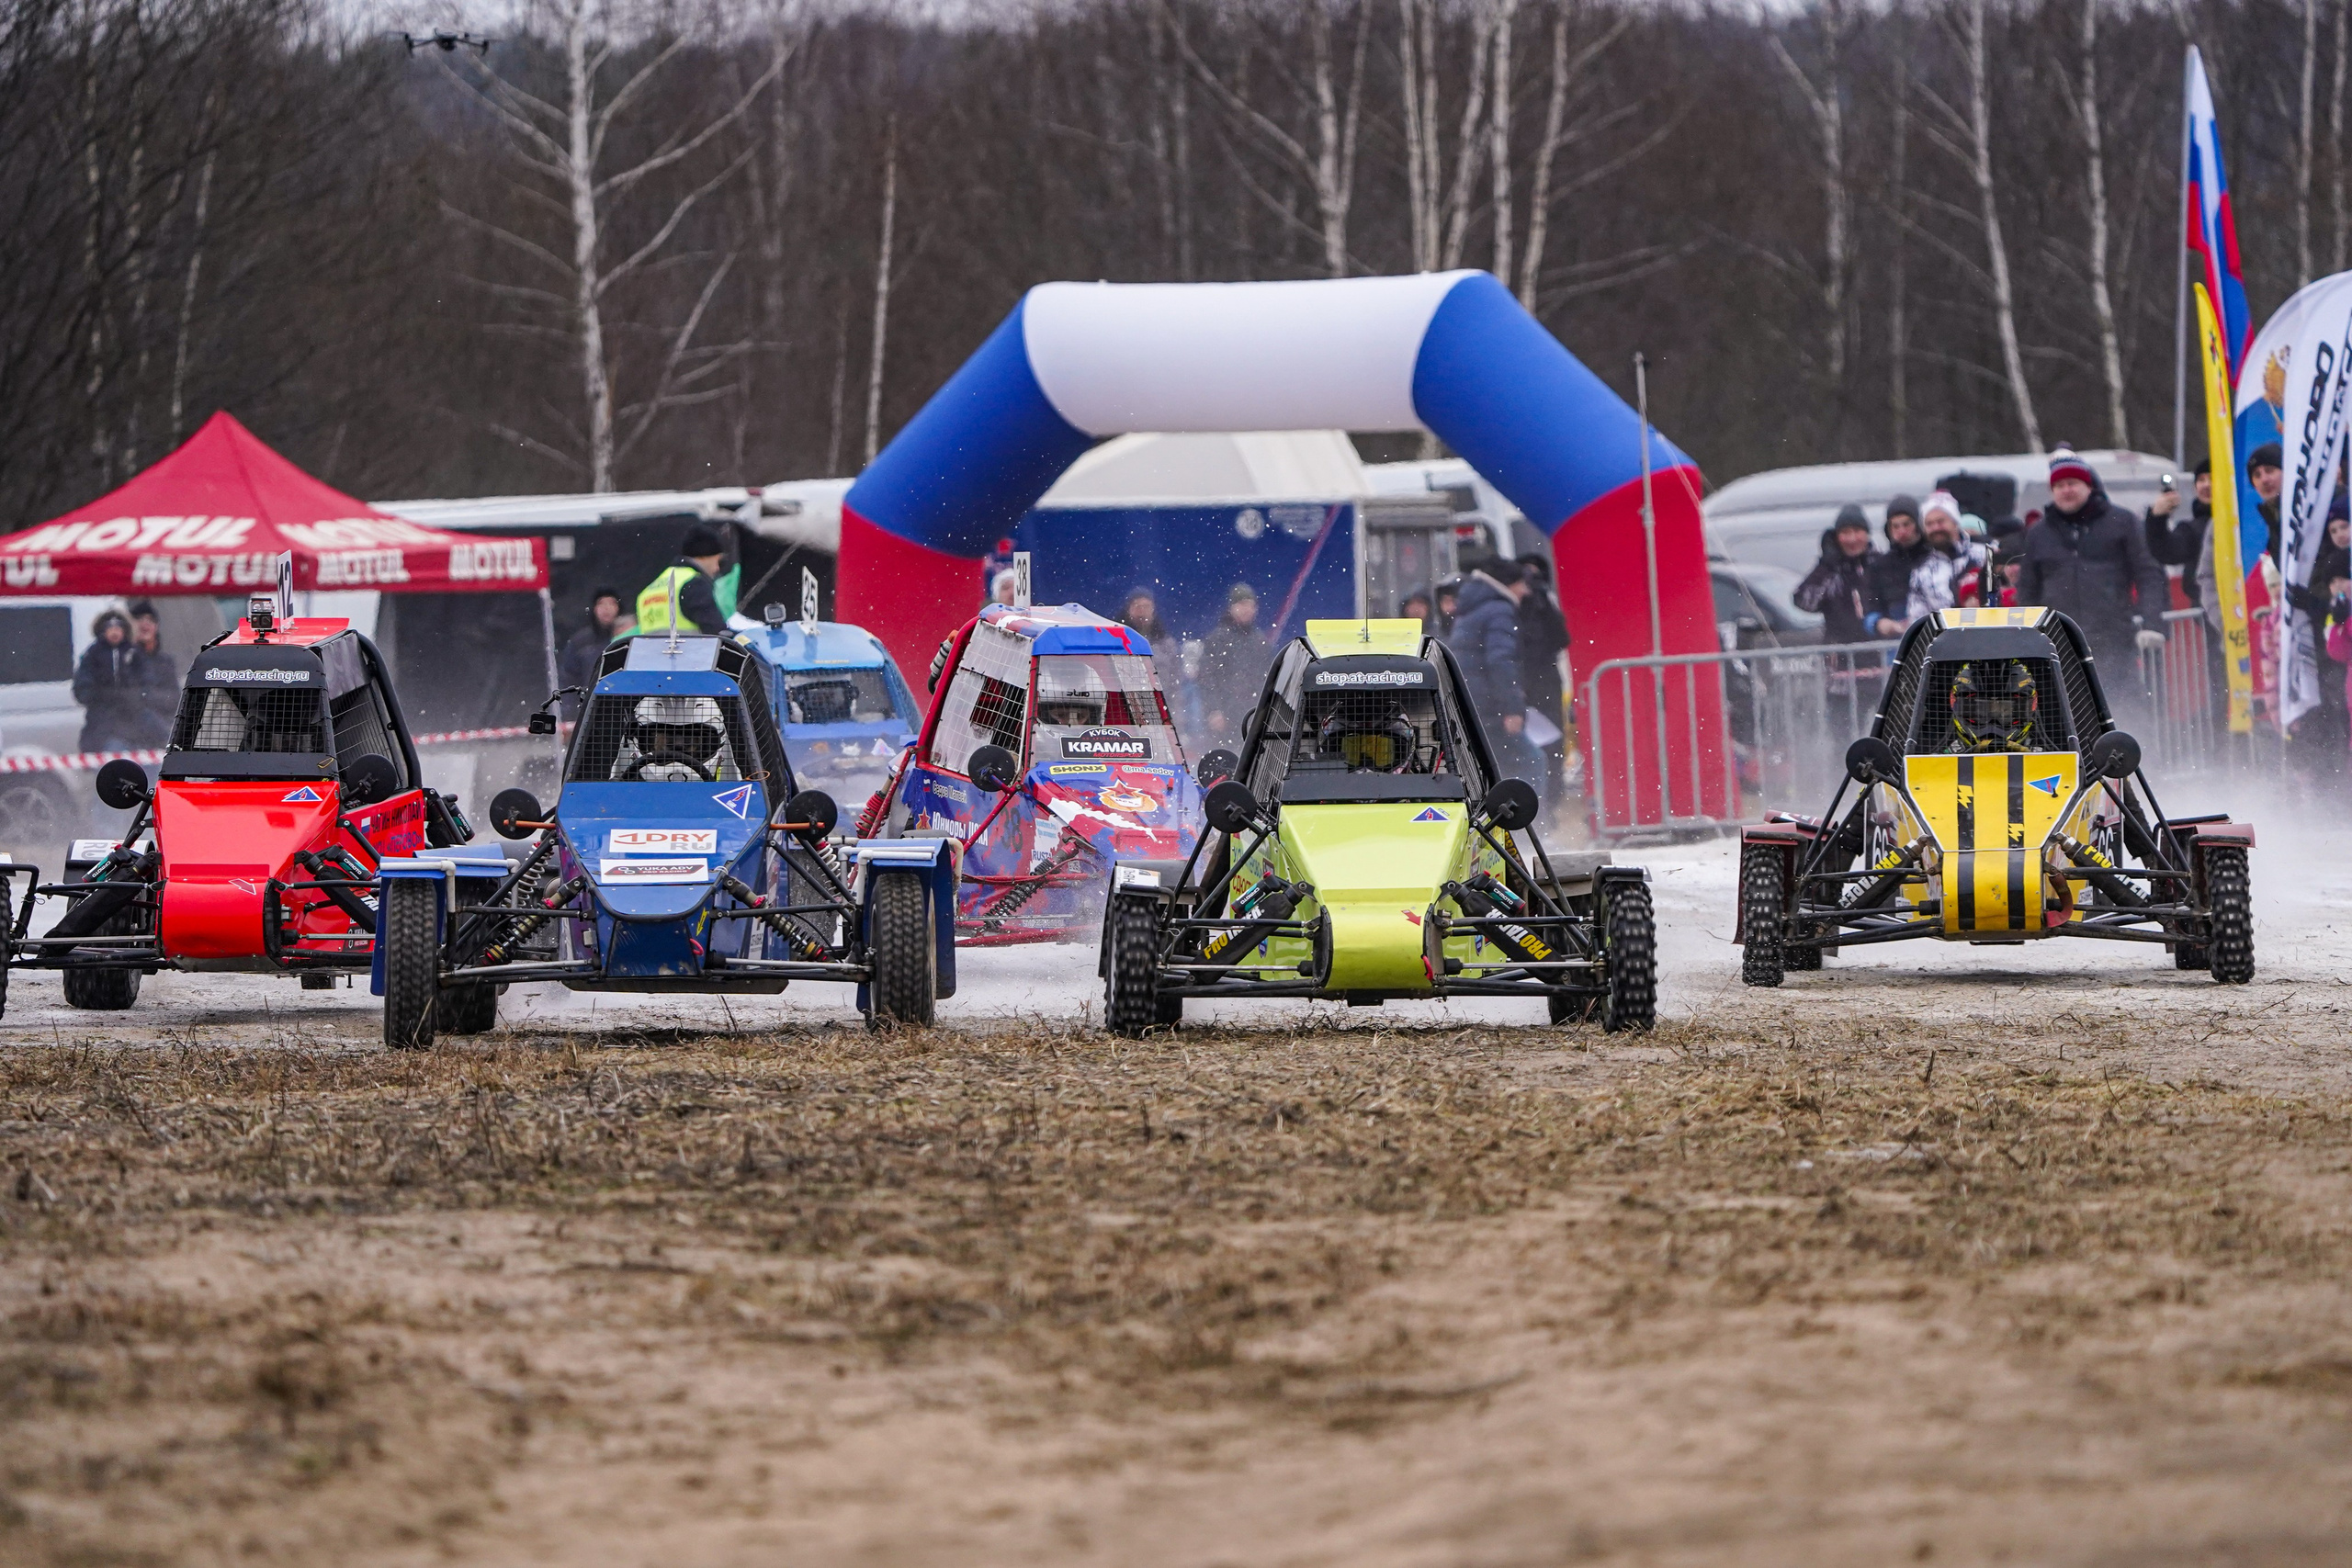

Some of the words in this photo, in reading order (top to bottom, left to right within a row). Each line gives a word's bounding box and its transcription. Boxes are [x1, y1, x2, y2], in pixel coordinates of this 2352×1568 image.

[5, 514, 256, 551] MOTUL
[316, 548, 412, 584] MOTUL
[449, 538, 538, 581] MOTUL
[1016, 558, 1027, 596] 38
[278, 560, 294, 620] 12
[804, 574, 816, 620] 25
[205, 668, 310, 683] shop.at-racing.ru
[1316, 670, 1423, 686] shop.at-racing.ru
[1089, 728, 1121, 738] КУБОК
[1068, 741, 1145, 753] KRAMAR
[933, 811, 966, 840] Юниоры
[614, 832, 711, 844] 1DRY
[670, 841, 712, 851] RU
[91, 860, 112, 878] CFMOTO
[343, 858, 363, 875] CFMOTO
[1239, 886, 1261, 906] CFMOTO
[1493, 887, 1514, 906] CFMOTO
